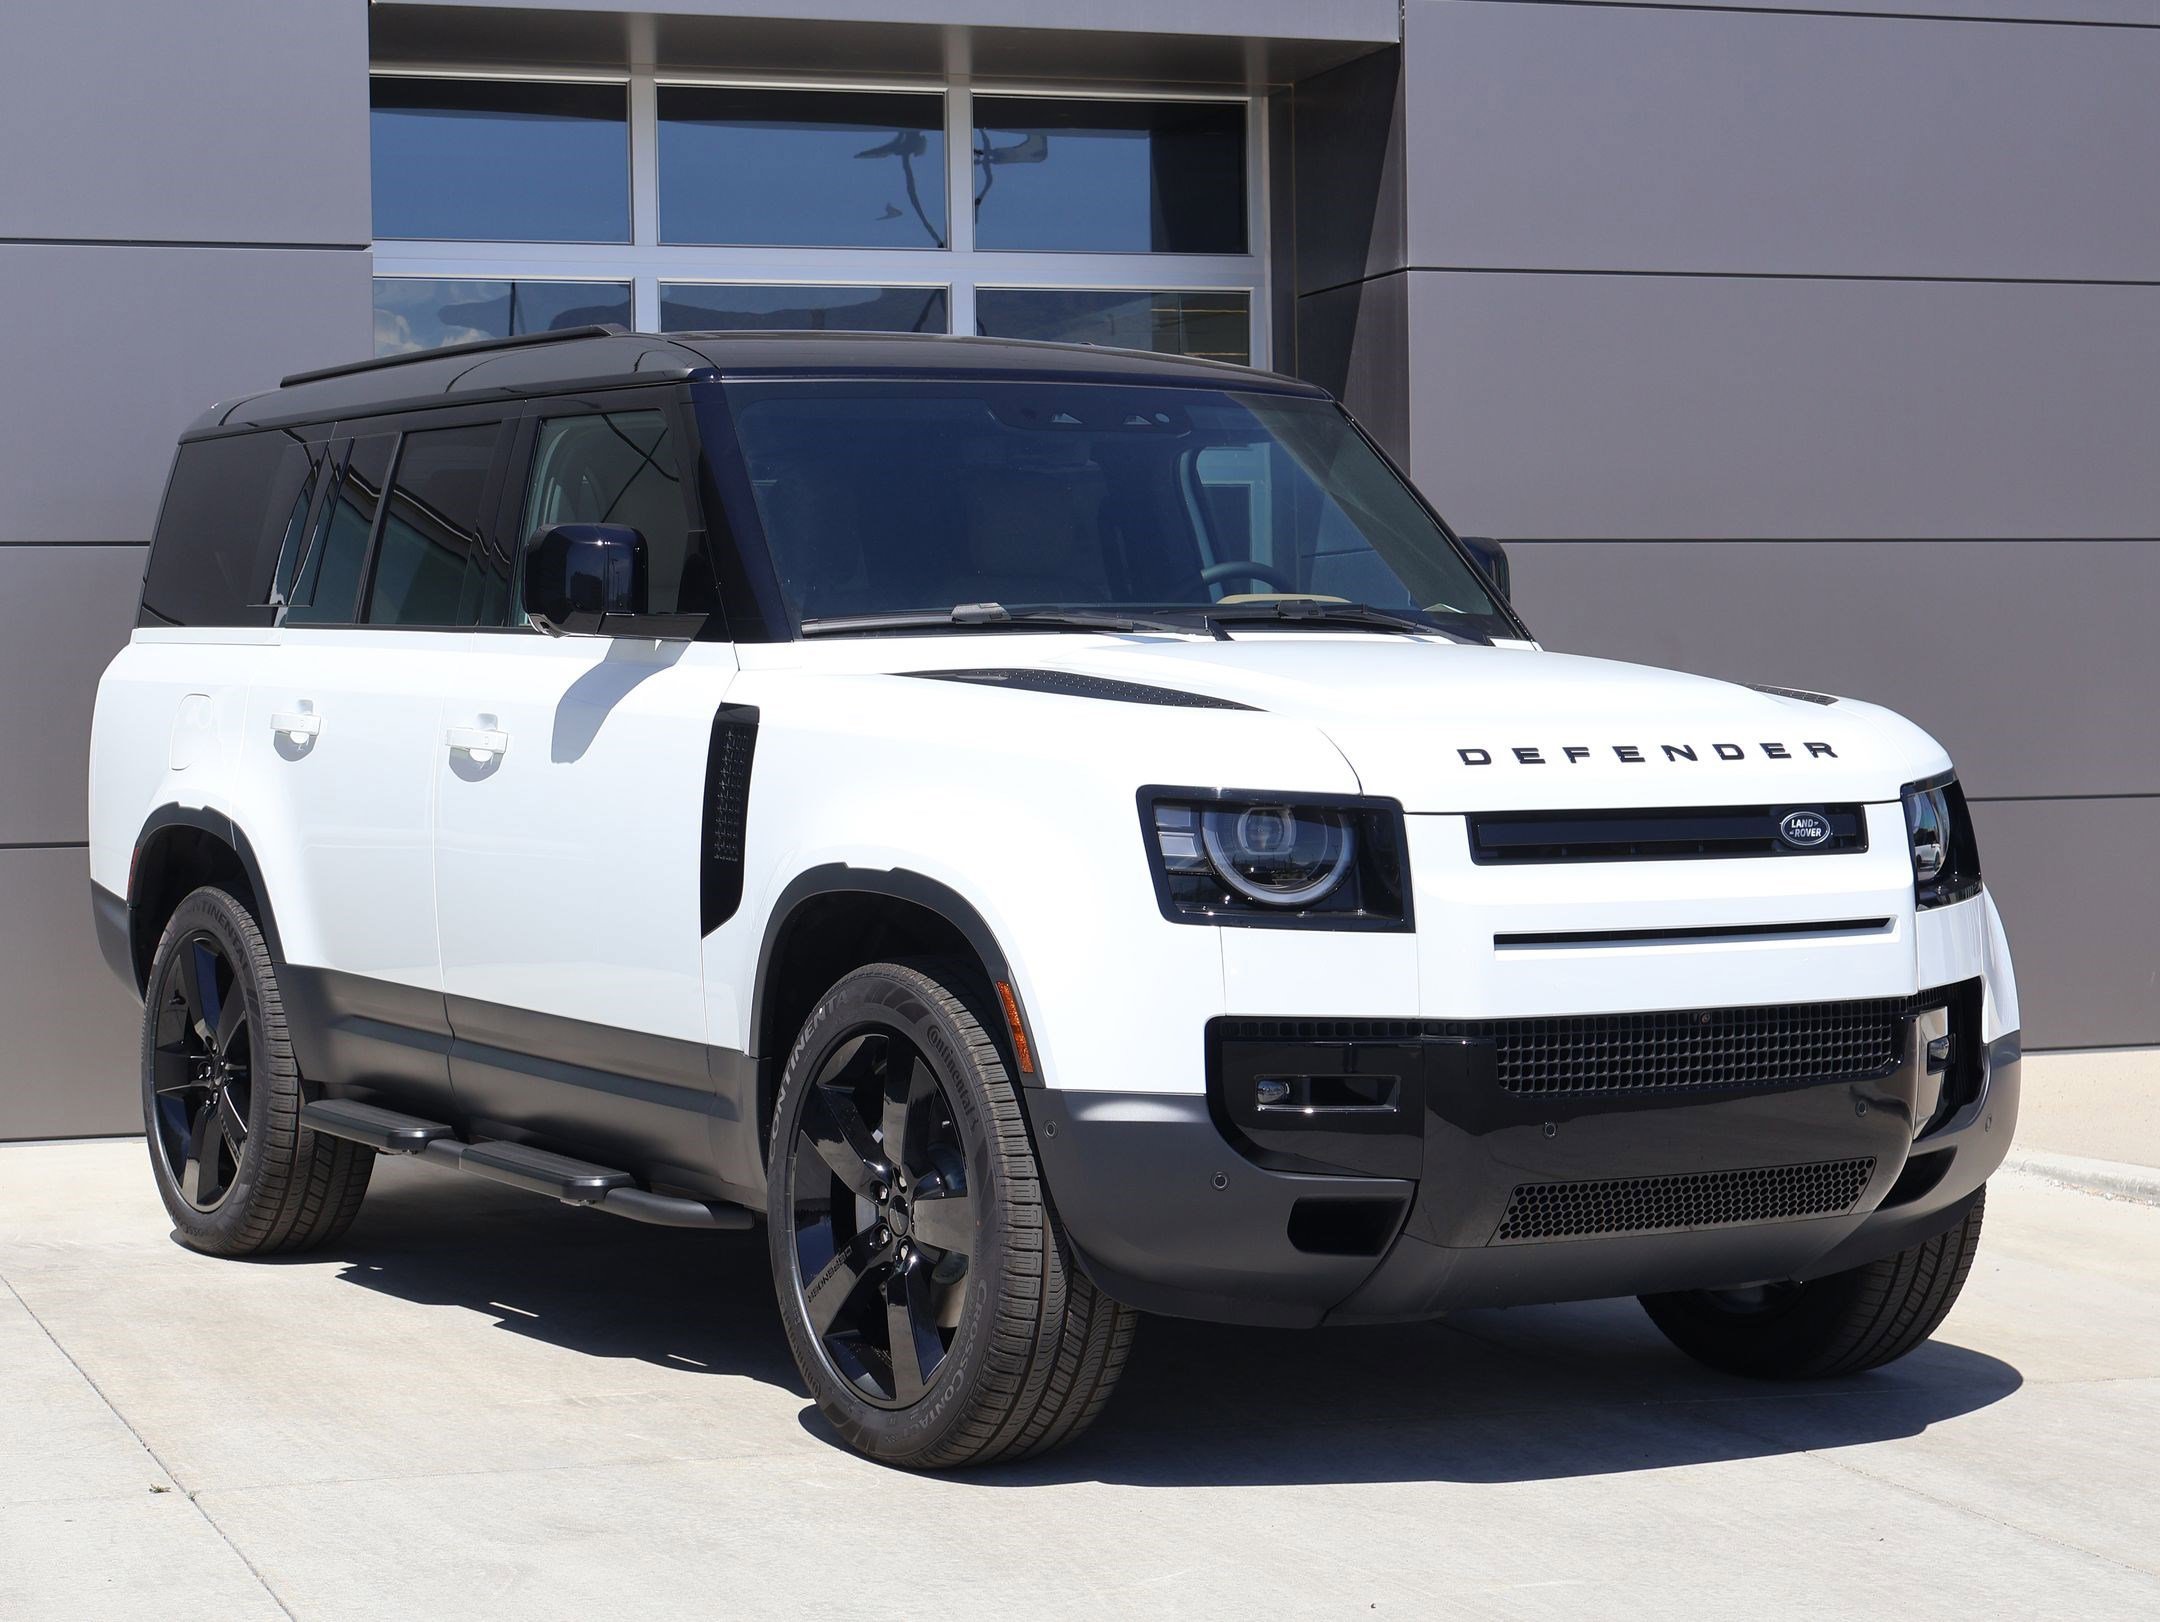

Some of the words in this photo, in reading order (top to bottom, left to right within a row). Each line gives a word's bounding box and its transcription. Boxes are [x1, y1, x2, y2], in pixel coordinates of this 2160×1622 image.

[1456, 742, 1839, 766] DEFENDER
[1791, 818, 1814, 828] LAND
[1794, 827, 1822, 838] ROVER
[768, 988, 852, 1165] CONTINENTA
[926, 1024, 976, 1116] Continental
[807, 1244, 853, 1304] DEFENDER
